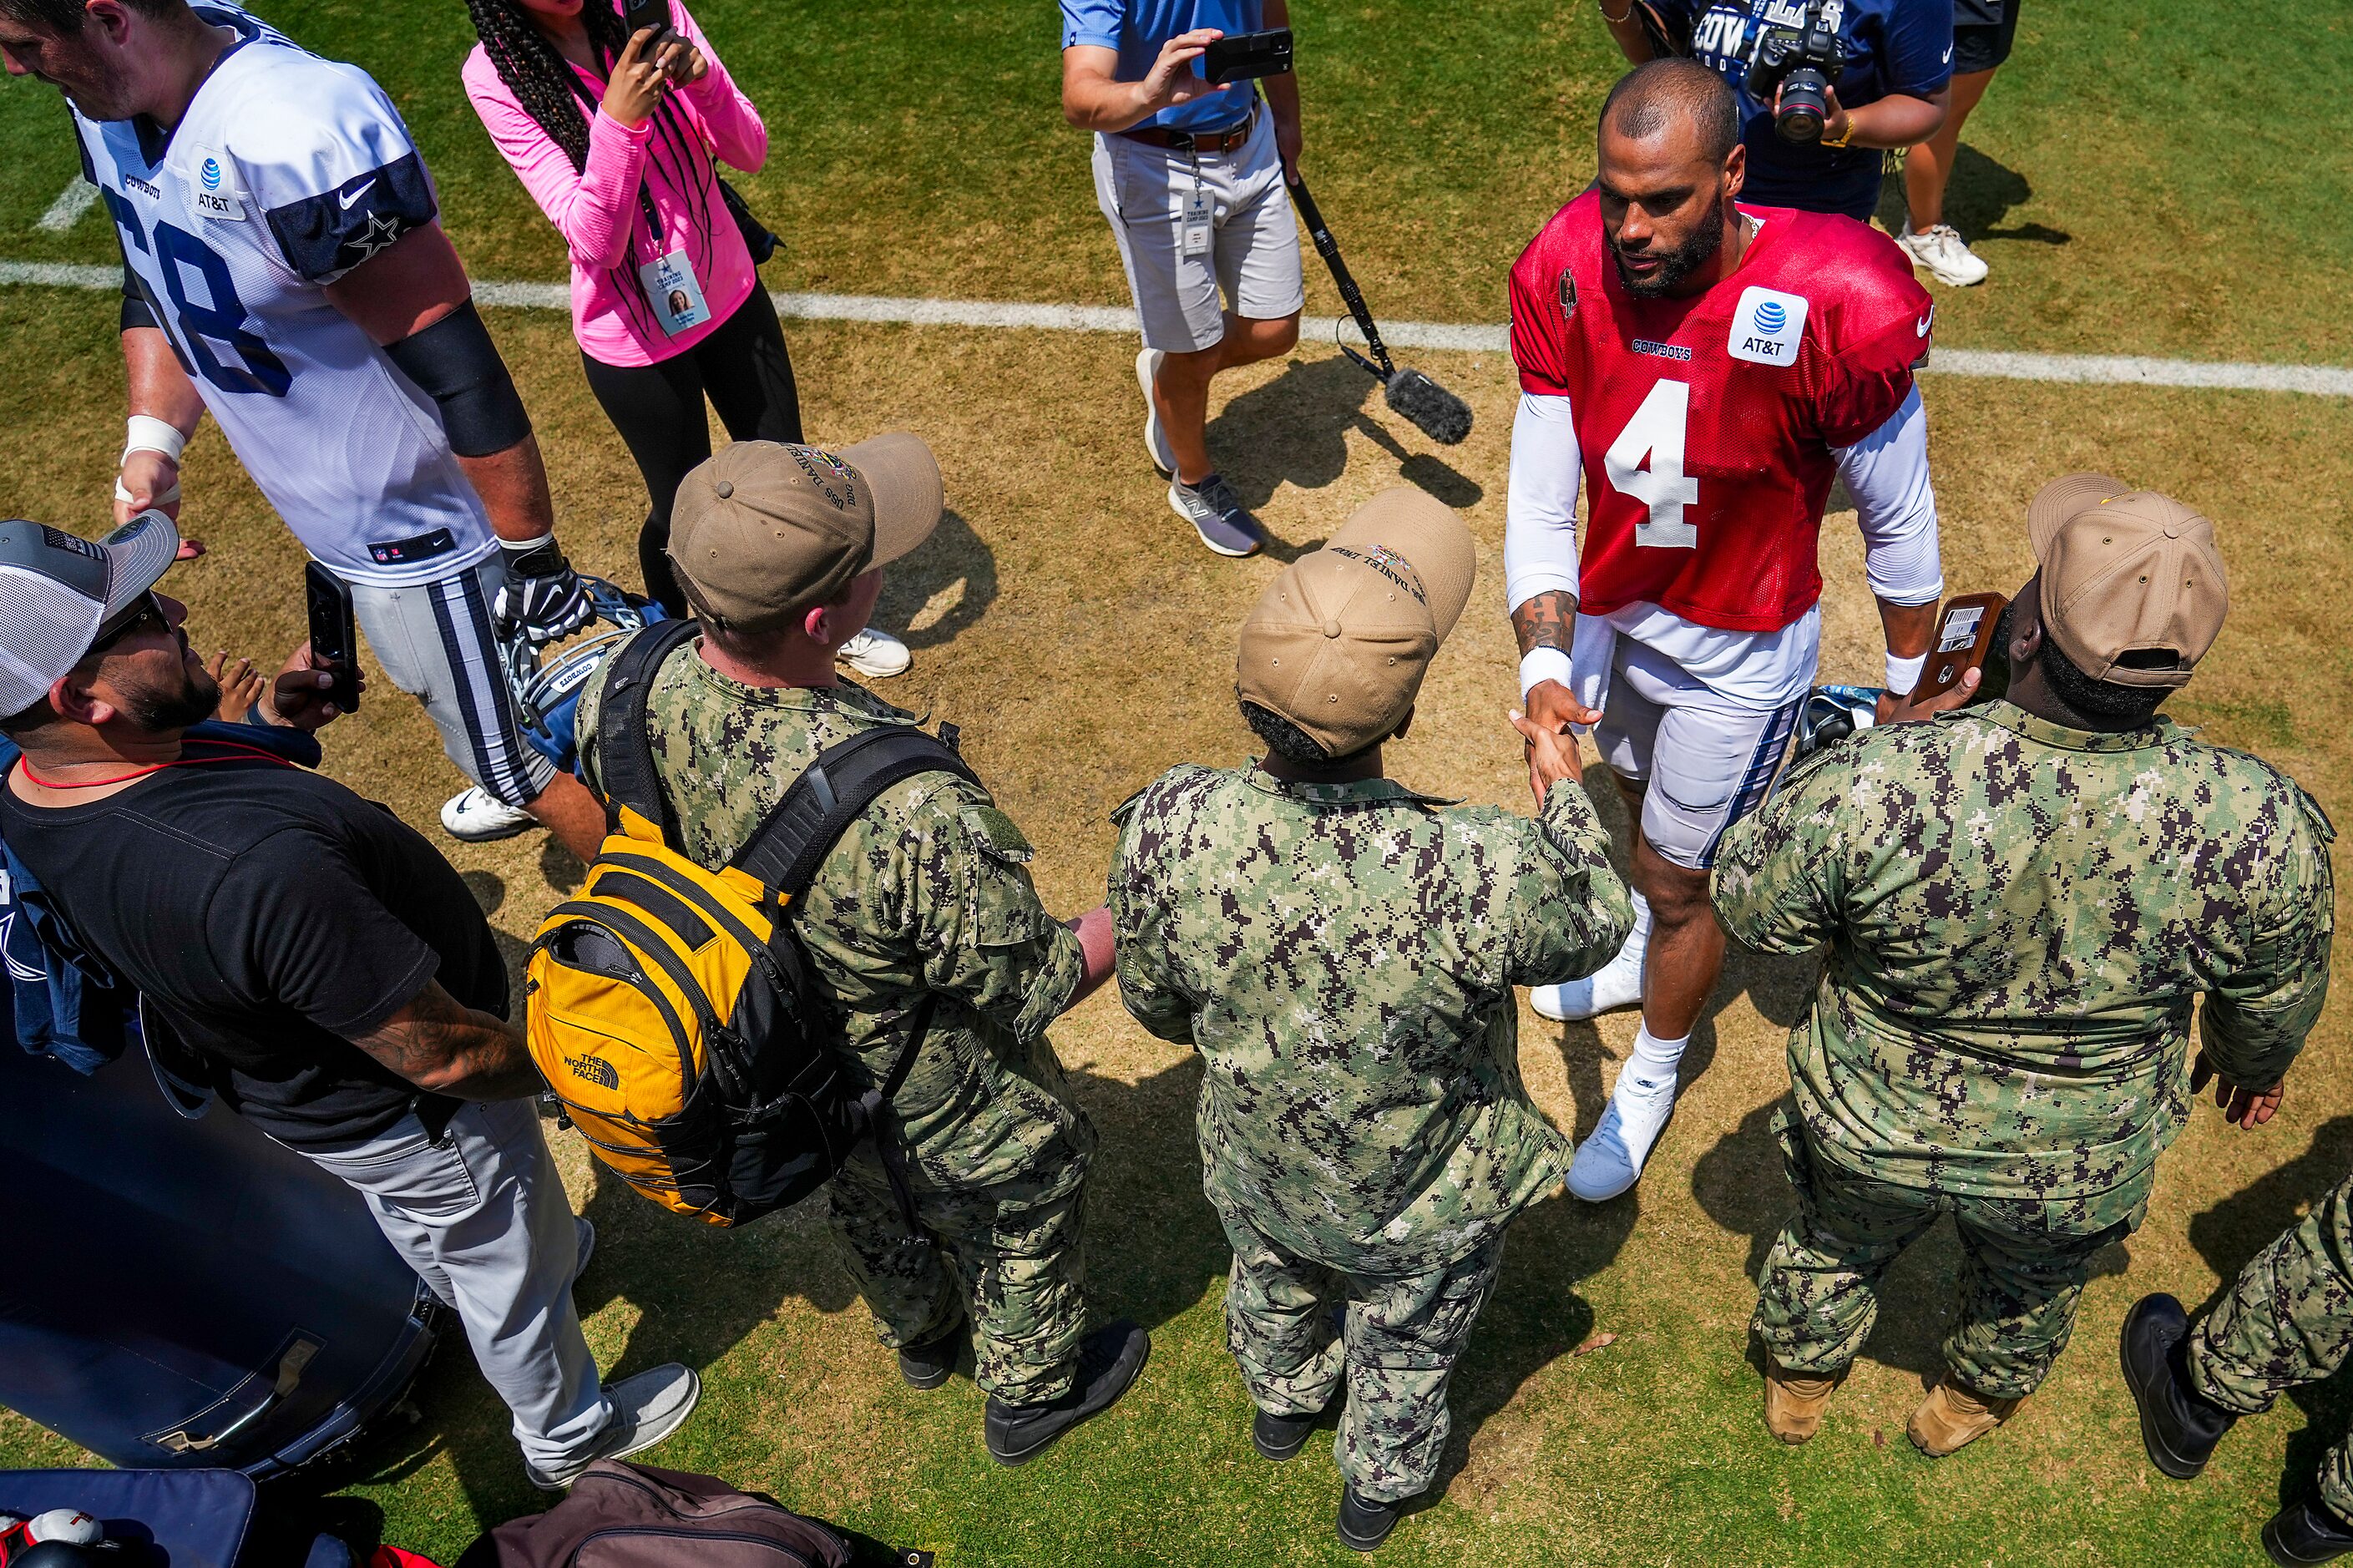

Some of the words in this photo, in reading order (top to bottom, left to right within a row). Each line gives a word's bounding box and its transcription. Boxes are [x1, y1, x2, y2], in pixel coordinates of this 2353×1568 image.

[125, 173, 161, 200] COWBOYS
[198, 193, 229, 212] AT&T
[656, 271, 682, 285] TRAINING
[658, 279, 672, 291] CAMP
[672, 276, 684, 285] 2023
[1632, 338, 1692, 361] COWBOYS
[1742, 336, 1785, 357] AT&T
[1603, 377, 1698, 549] 4
[824, 487, 844, 512] USS
[845, 483, 857, 508] DDG
[1363, 556, 1409, 593] DANIEL
[559, 663, 593, 688] COWBOYS
[564, 1055, 601, 1075] NORTH
[580, 1053, 602, 1066] THE
[573, 1067, 600, 1084] FACE
